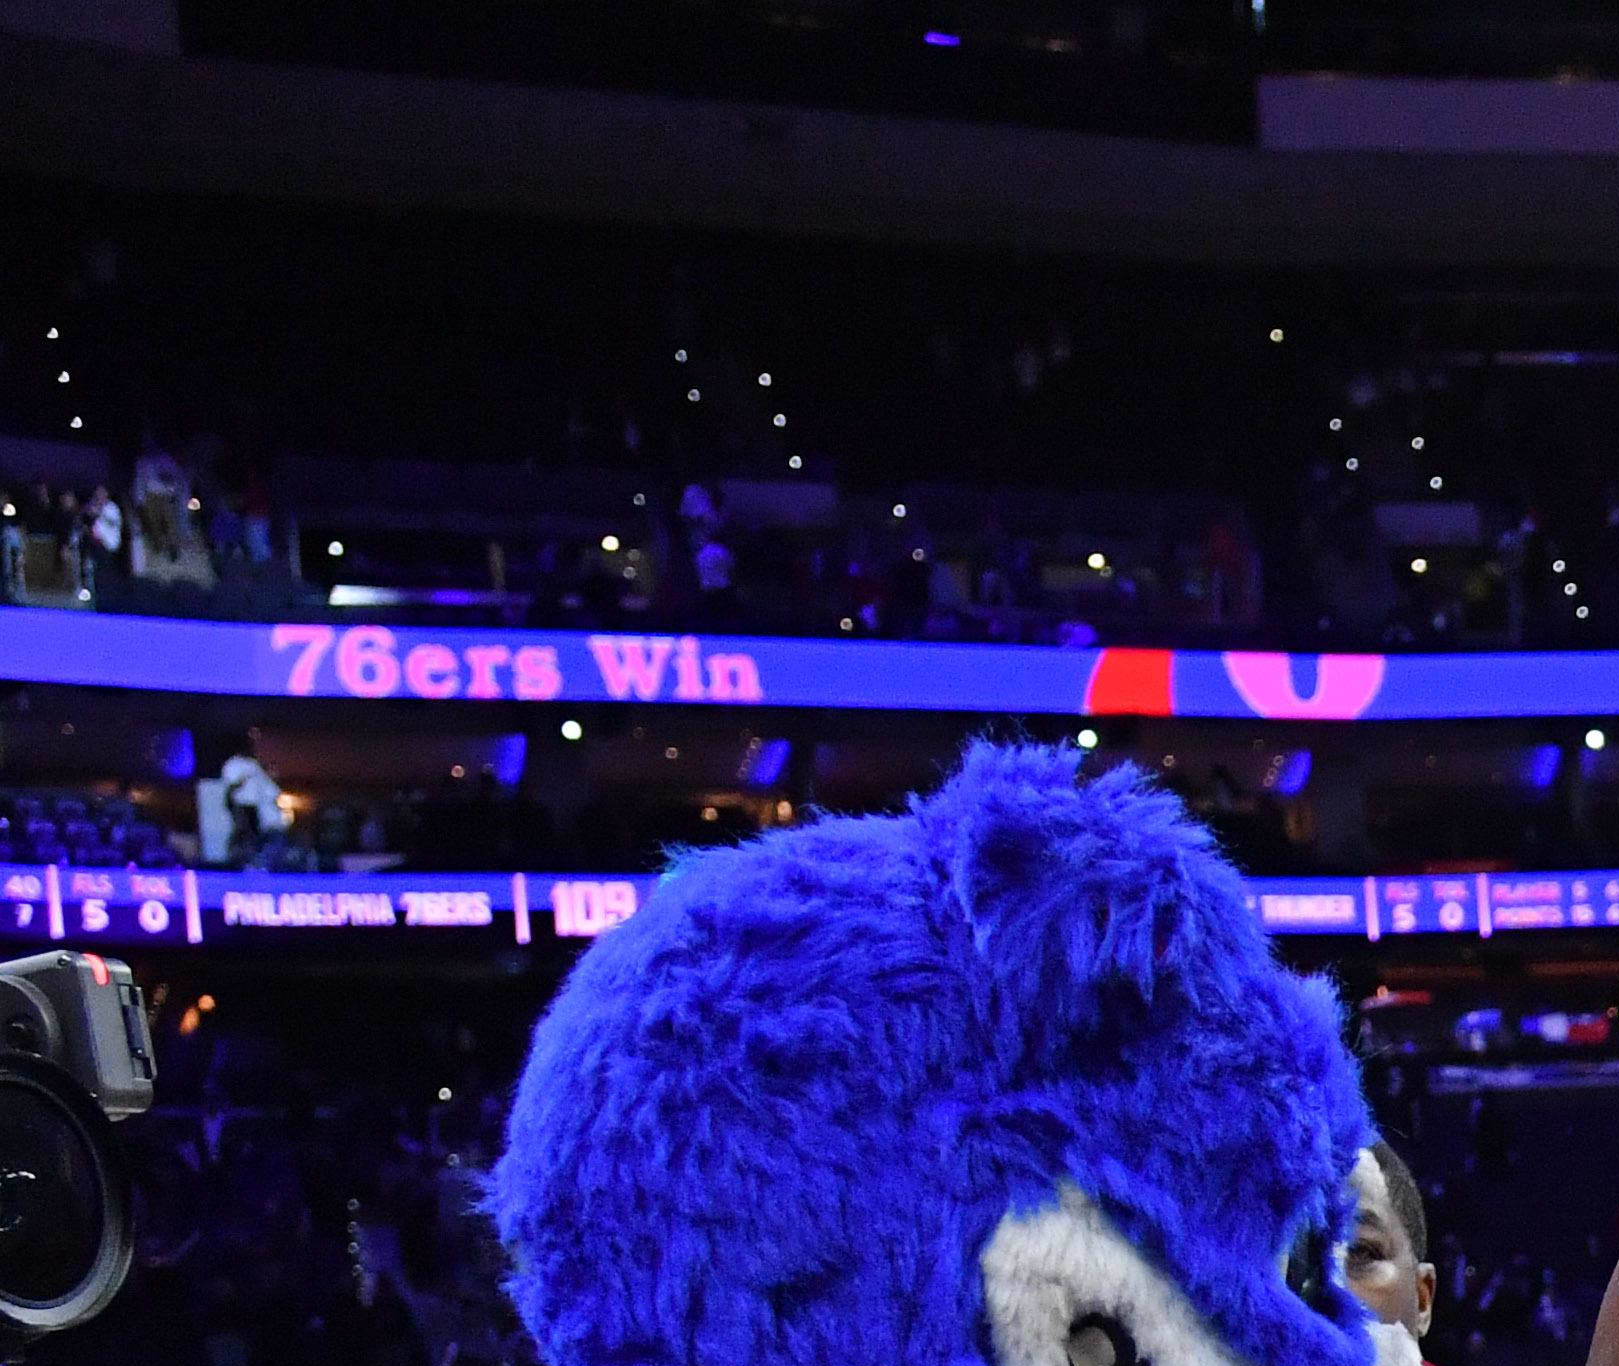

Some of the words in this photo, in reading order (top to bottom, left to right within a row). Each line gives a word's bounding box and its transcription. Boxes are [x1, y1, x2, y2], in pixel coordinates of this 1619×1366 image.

[271, 624, 563, 700] 76ers
[588, 634, 763, 701] Win
[82, 899, 110, 932] 5
[138, 900, 169, 933] 0
[223, 890, 396, 926] PHILADELPHIA
[403, 891, 493, 926] 76ERS
[551, 881, 636, 937] 109
[1392, 903, 1416, 932] 5
[1439, 901, 1464, 932] 0
